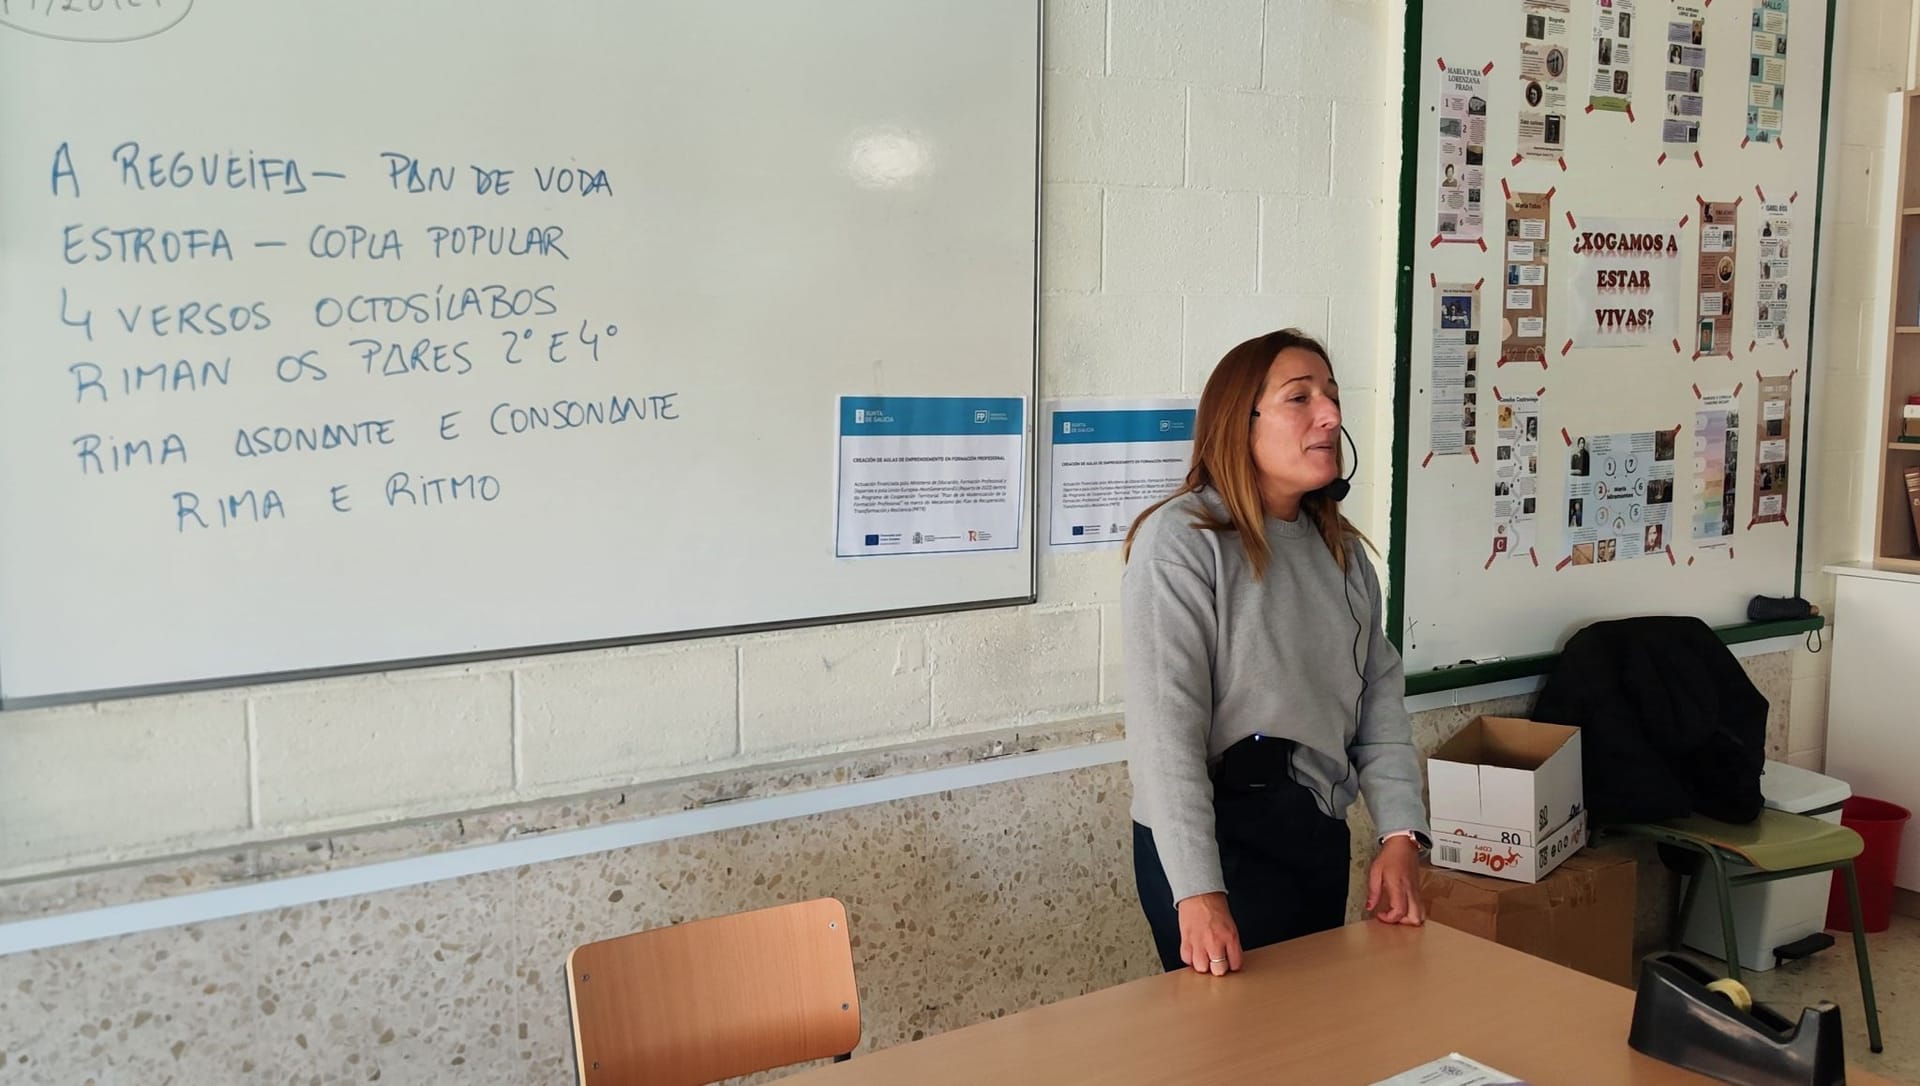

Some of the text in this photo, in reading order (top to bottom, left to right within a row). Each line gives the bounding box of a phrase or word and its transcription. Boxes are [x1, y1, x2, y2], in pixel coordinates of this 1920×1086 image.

[51, 141, 81, 199] A
[379, 151, 456, 194] PAN
[470, 163, 515, 196] DE
[533, 165, 614, 198] VODA
[64, 223, 234, 265] ESTROFA
[308, 224, 404, 261] COPLA
[427, 224, 570, 261] POPULAR
[1573, 232, 1678, 254] ¿XOGAMOS A
[1596, 270, 1650, 288] ESTAR
[60, 287, 93, 342] 4
[118, 301, 272, 337] VERSOS
[1595, 308, 1654, 326] VIVAS?
[69, 357, 232, 404] RIMAN
[276, 349, 328, 384] OS
[348, 337, 473, 377] PARES
[234, 419, 395, 458] ASONANTE
[439, 410, 462, 441] E
[489, 392, 680, 436] CONSONANTE
[171, 489, 286, 533] RIMA
[330, 484, 352, 513] E
[1501, 832, 1521, 846] 80
